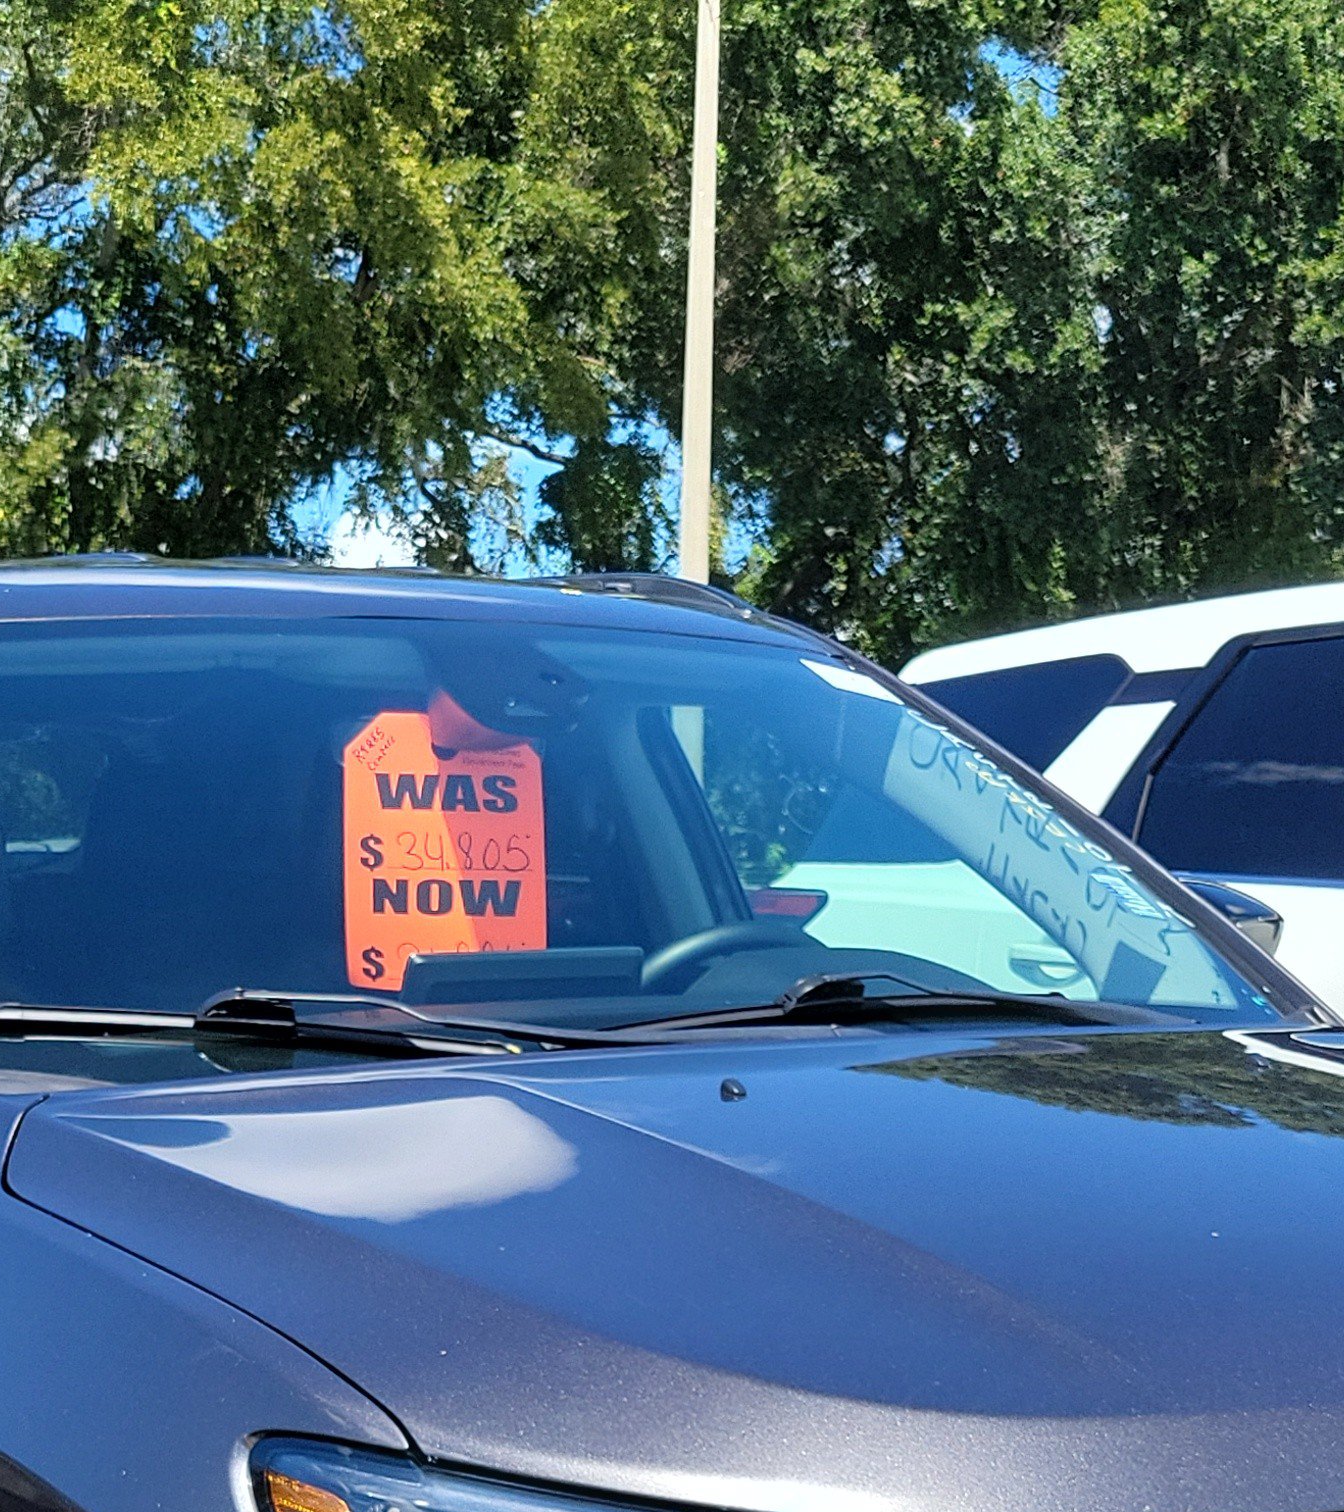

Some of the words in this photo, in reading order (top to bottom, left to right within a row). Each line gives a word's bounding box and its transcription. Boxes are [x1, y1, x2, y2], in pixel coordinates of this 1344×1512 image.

[374, 773, 519, 813] WAS
[360, 834, 384, 872] $
[372, 878, 521, 917] NOW
[362, 946, 385, 982] $
